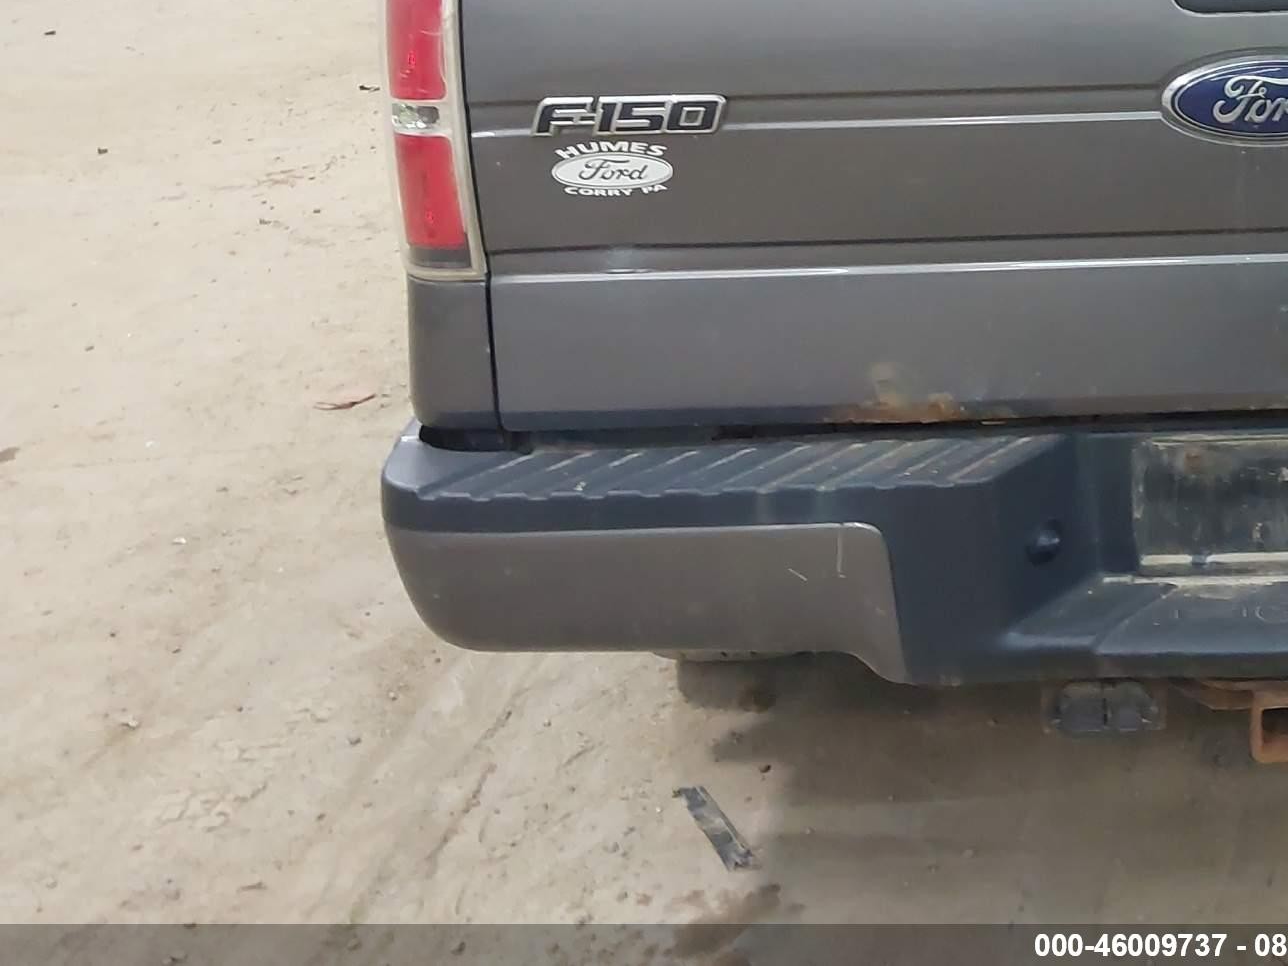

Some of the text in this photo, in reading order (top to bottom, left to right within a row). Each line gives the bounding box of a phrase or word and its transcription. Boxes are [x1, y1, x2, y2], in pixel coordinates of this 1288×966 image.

[531, 94, 727, 137] F-150
[555, 141, 668, 160] HUMES
[578, 158, 649, 181] Ford
[564, 184, 668, 197] CORRY PA
